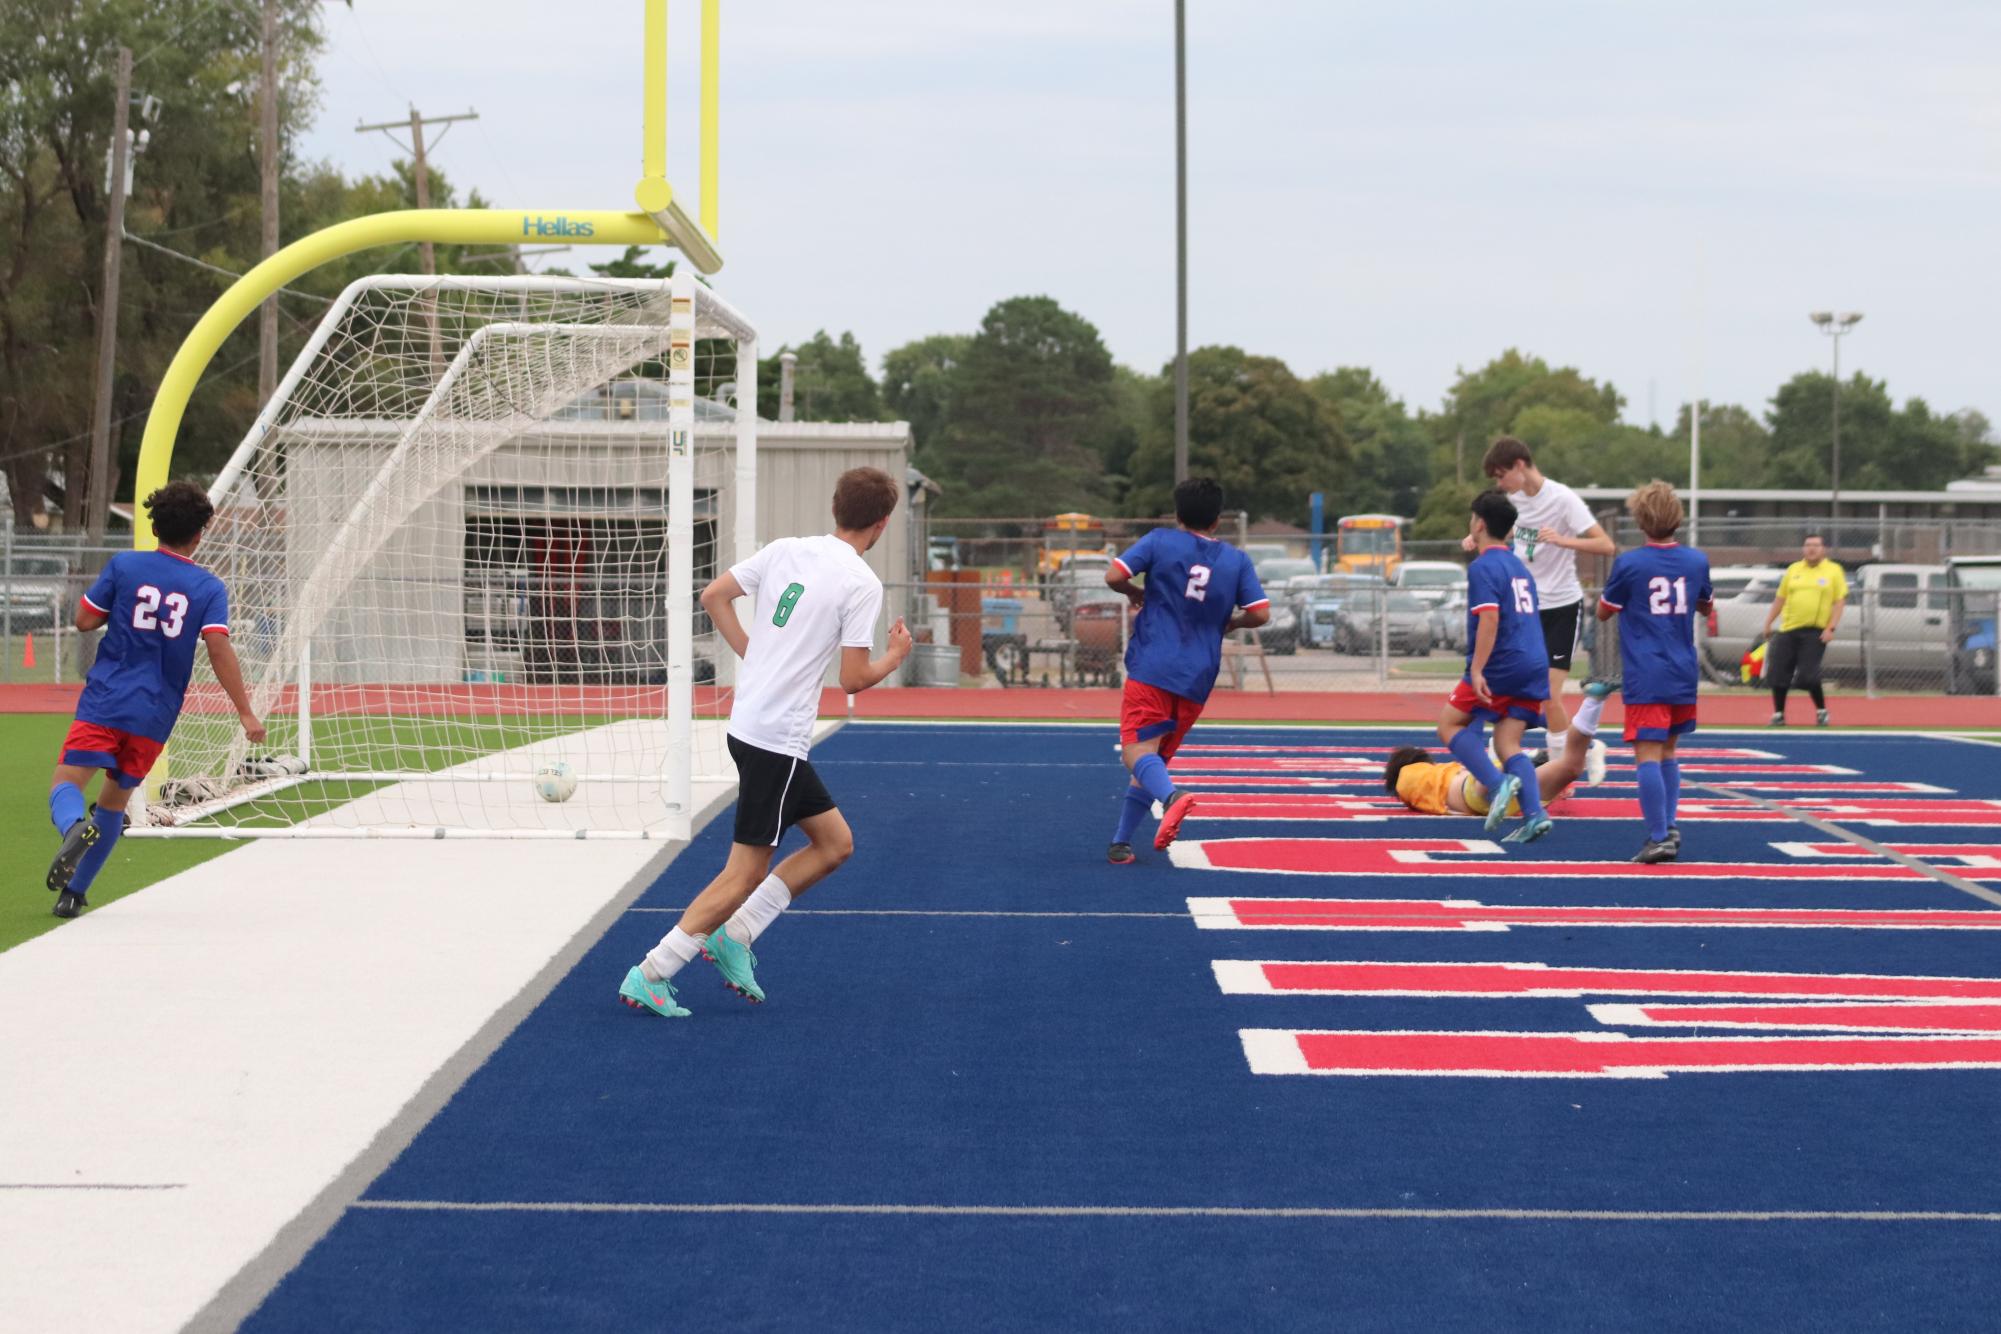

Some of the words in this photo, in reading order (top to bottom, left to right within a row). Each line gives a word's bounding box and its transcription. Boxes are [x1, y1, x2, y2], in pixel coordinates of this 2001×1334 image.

[523, 216, 594, 237] Hellas
[1185, 564, 1212, 602] 2
[1511, 577, 1535, 613] 15
[1648, 576, 1689, 615] 21
[132, 585, 190, 638] 23
[772, 582, 805, 628] 8
